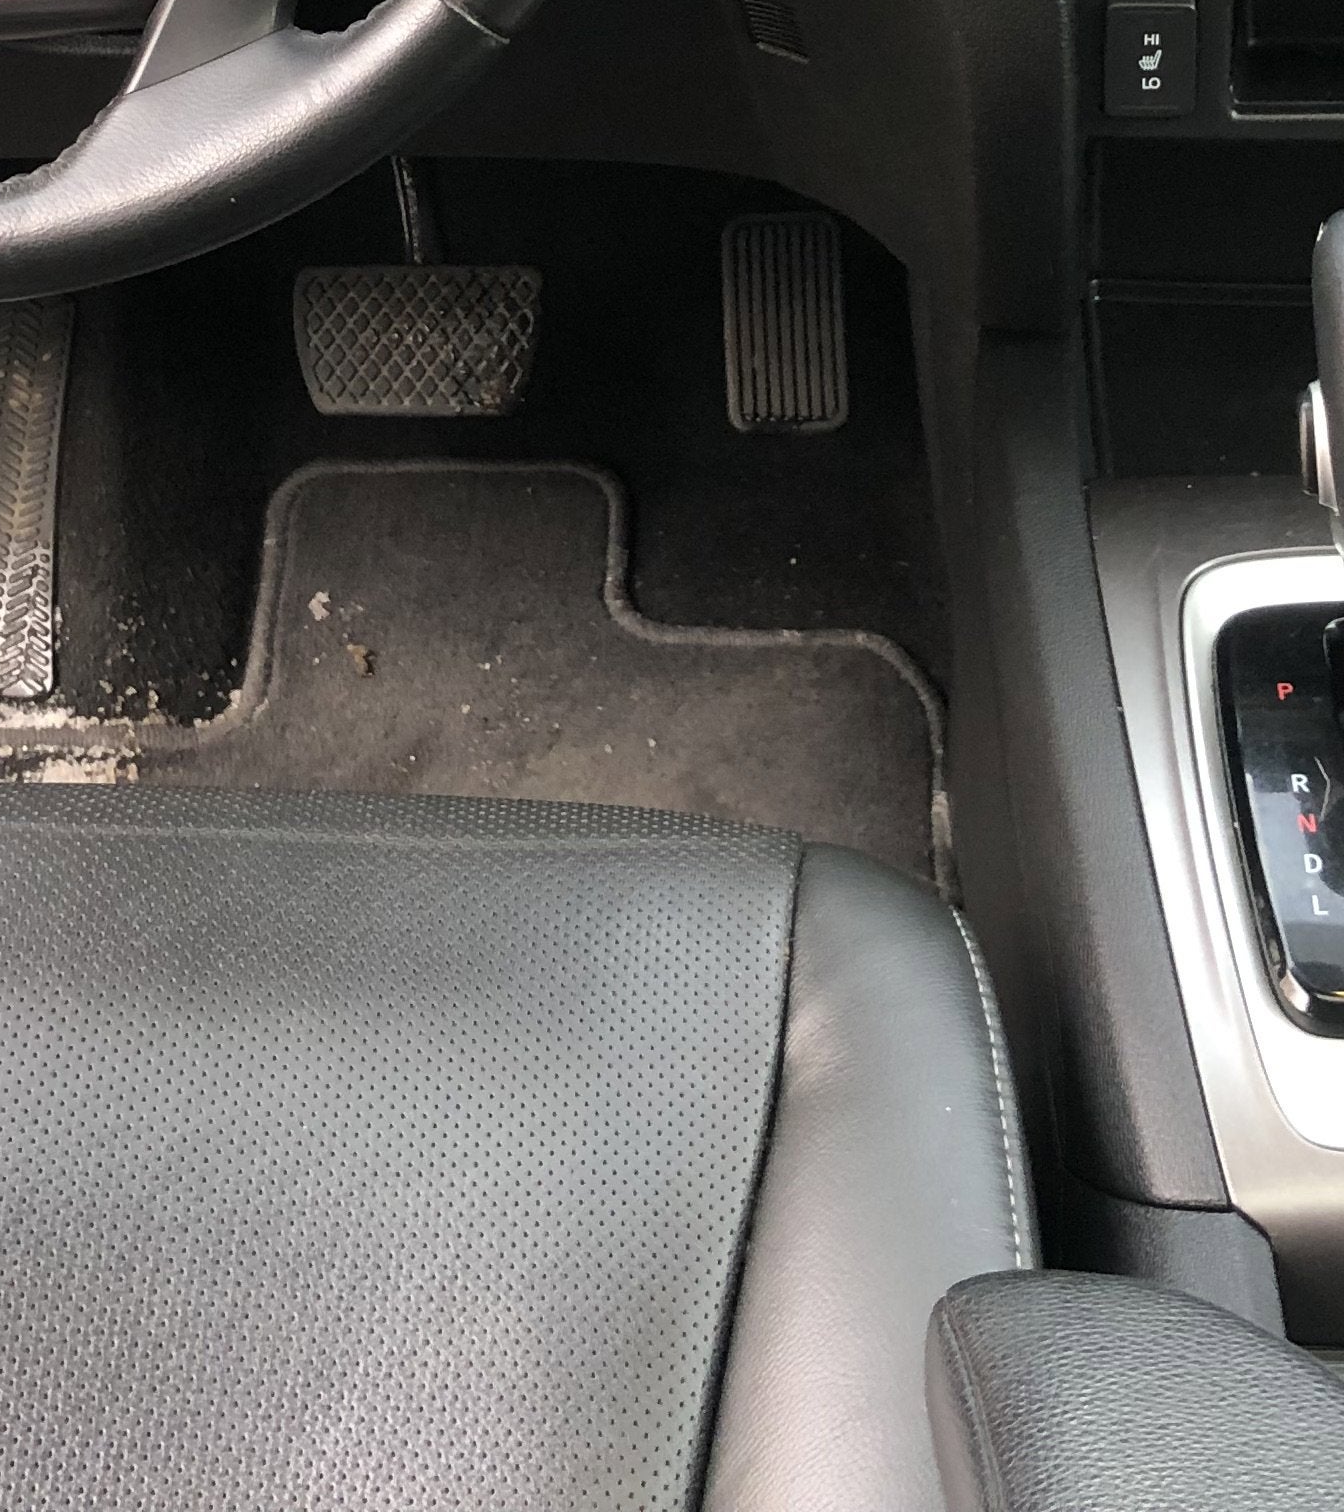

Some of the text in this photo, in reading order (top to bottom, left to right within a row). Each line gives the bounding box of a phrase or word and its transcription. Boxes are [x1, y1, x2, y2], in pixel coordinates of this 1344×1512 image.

[1144, 33, 1160, 46] HI
[1142, 77, 1161, 90] LO
[1276, 681, 1294, 701] P
[1291, 773, 1310, 794] R
[1297, 813, 1317, 834] N
[1304, 854, 1322, 875] D
[1312, 895, 1329, 917] L
